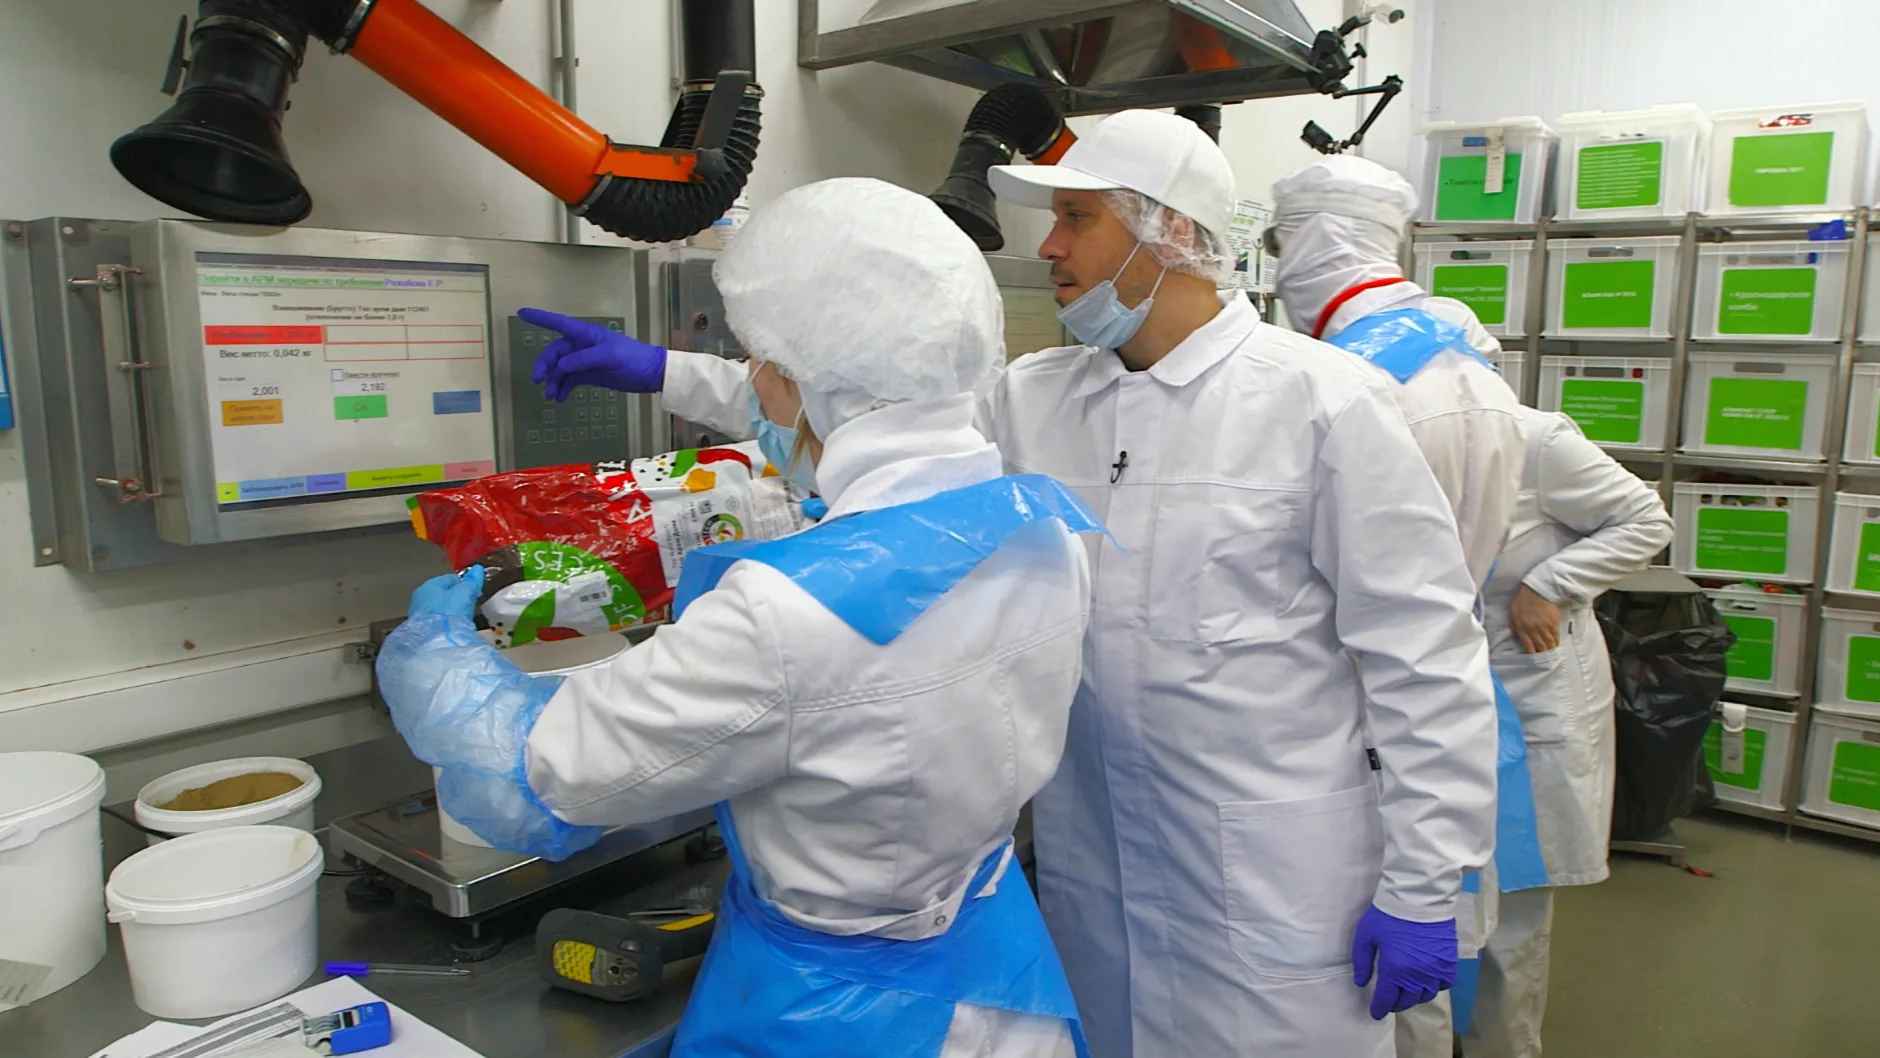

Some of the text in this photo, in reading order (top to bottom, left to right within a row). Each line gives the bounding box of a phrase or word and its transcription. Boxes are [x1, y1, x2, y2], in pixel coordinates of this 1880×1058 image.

[220, 349, 240, 358] Вес
[273, 348, 301, 359] 0,042
[252, 386, 280, 396] 2,001
